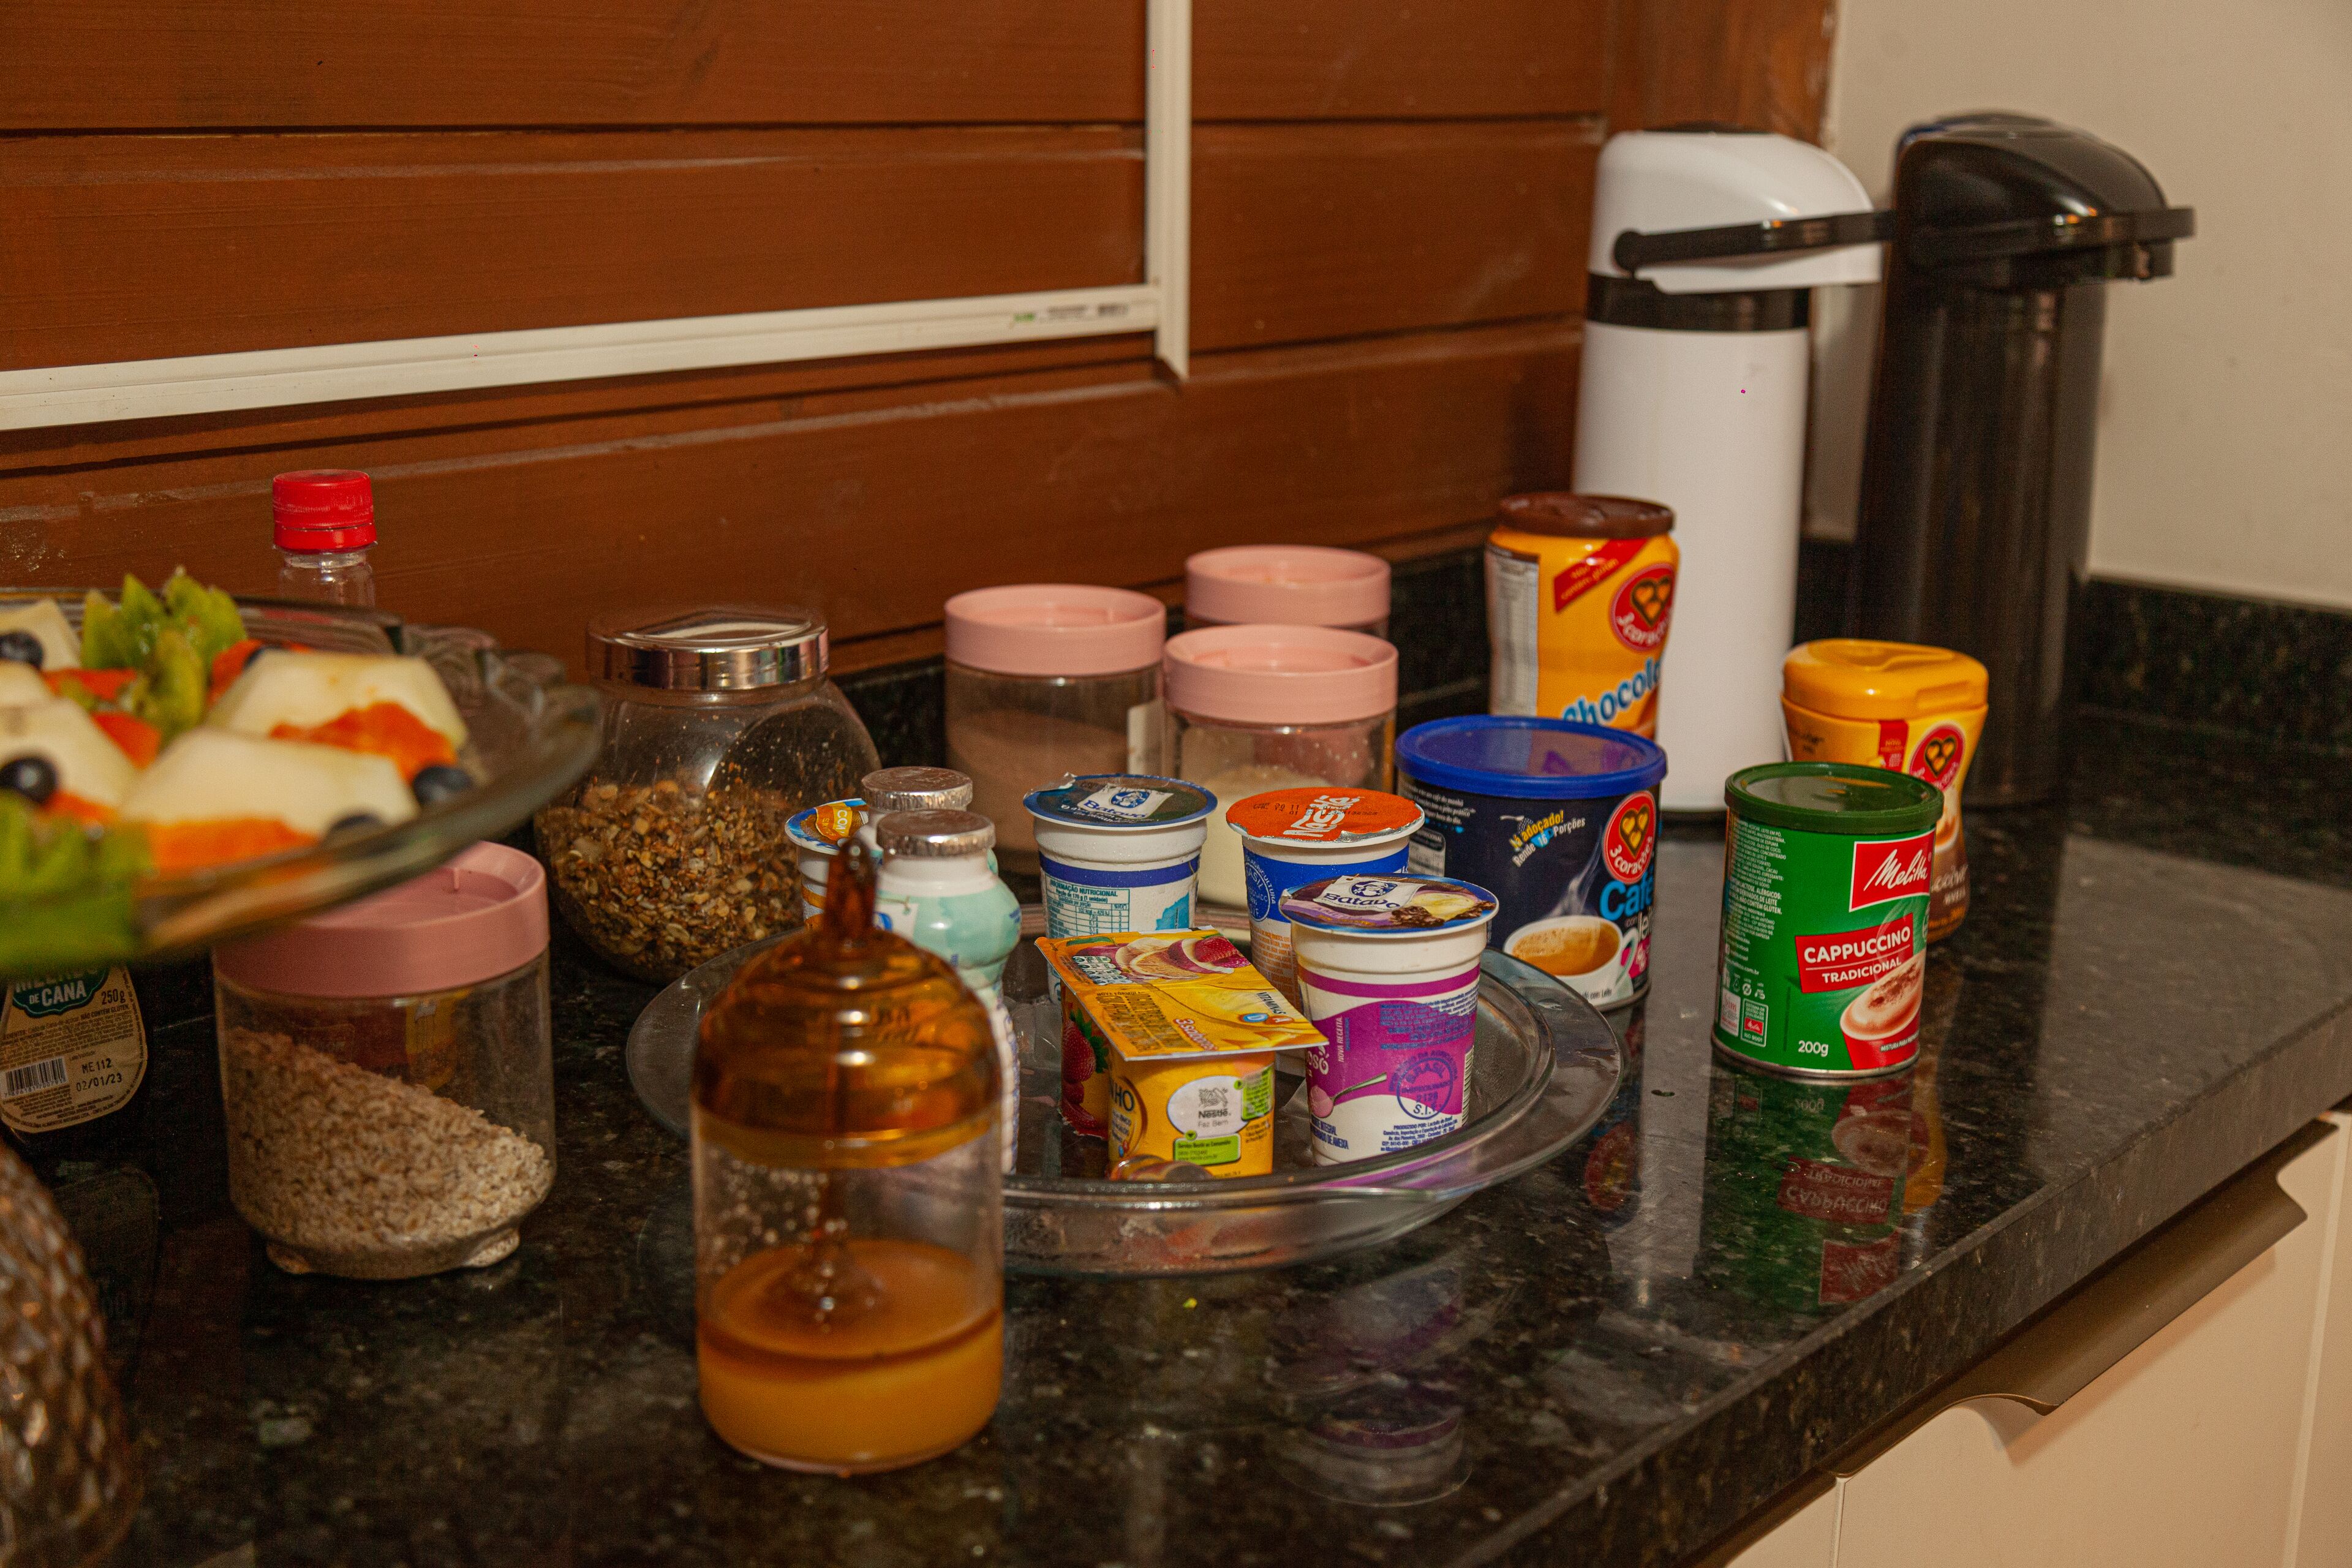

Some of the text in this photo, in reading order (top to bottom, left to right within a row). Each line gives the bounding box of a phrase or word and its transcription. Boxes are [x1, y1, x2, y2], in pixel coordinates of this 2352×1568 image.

[1521, 809, 1564, 842] adoçado!
[1512, 843, 1536, 867] Rende
[1553, 817, 1586, 837] Porções
[1610, 835, 1653, 875] 3 corações
[1863, 849, 1928, 892] Melitta
[1050, 880, 1118, 897] INFORMAÇÃO NUTRICIONAL
[1324, 892, 1400, 909] Batavo
[1756, 888, 1782, 900] ALÉRGICOS:
[1765, 898, 1777, 907] LEITE
[1804, 926, 1910, 963] CAPPUCCINO
[1822, 957, 1902, 983] TRADICIONAL
[29, 980, 87, 1008] DE CANA
[101, 989, 126, 1005] 250 g
[1256, 991, 1286, 1015] VITAMINAS
[1798, 1040, 1829, 1057] 200g
[75, 1072, 123, 1092] 02/01/23
